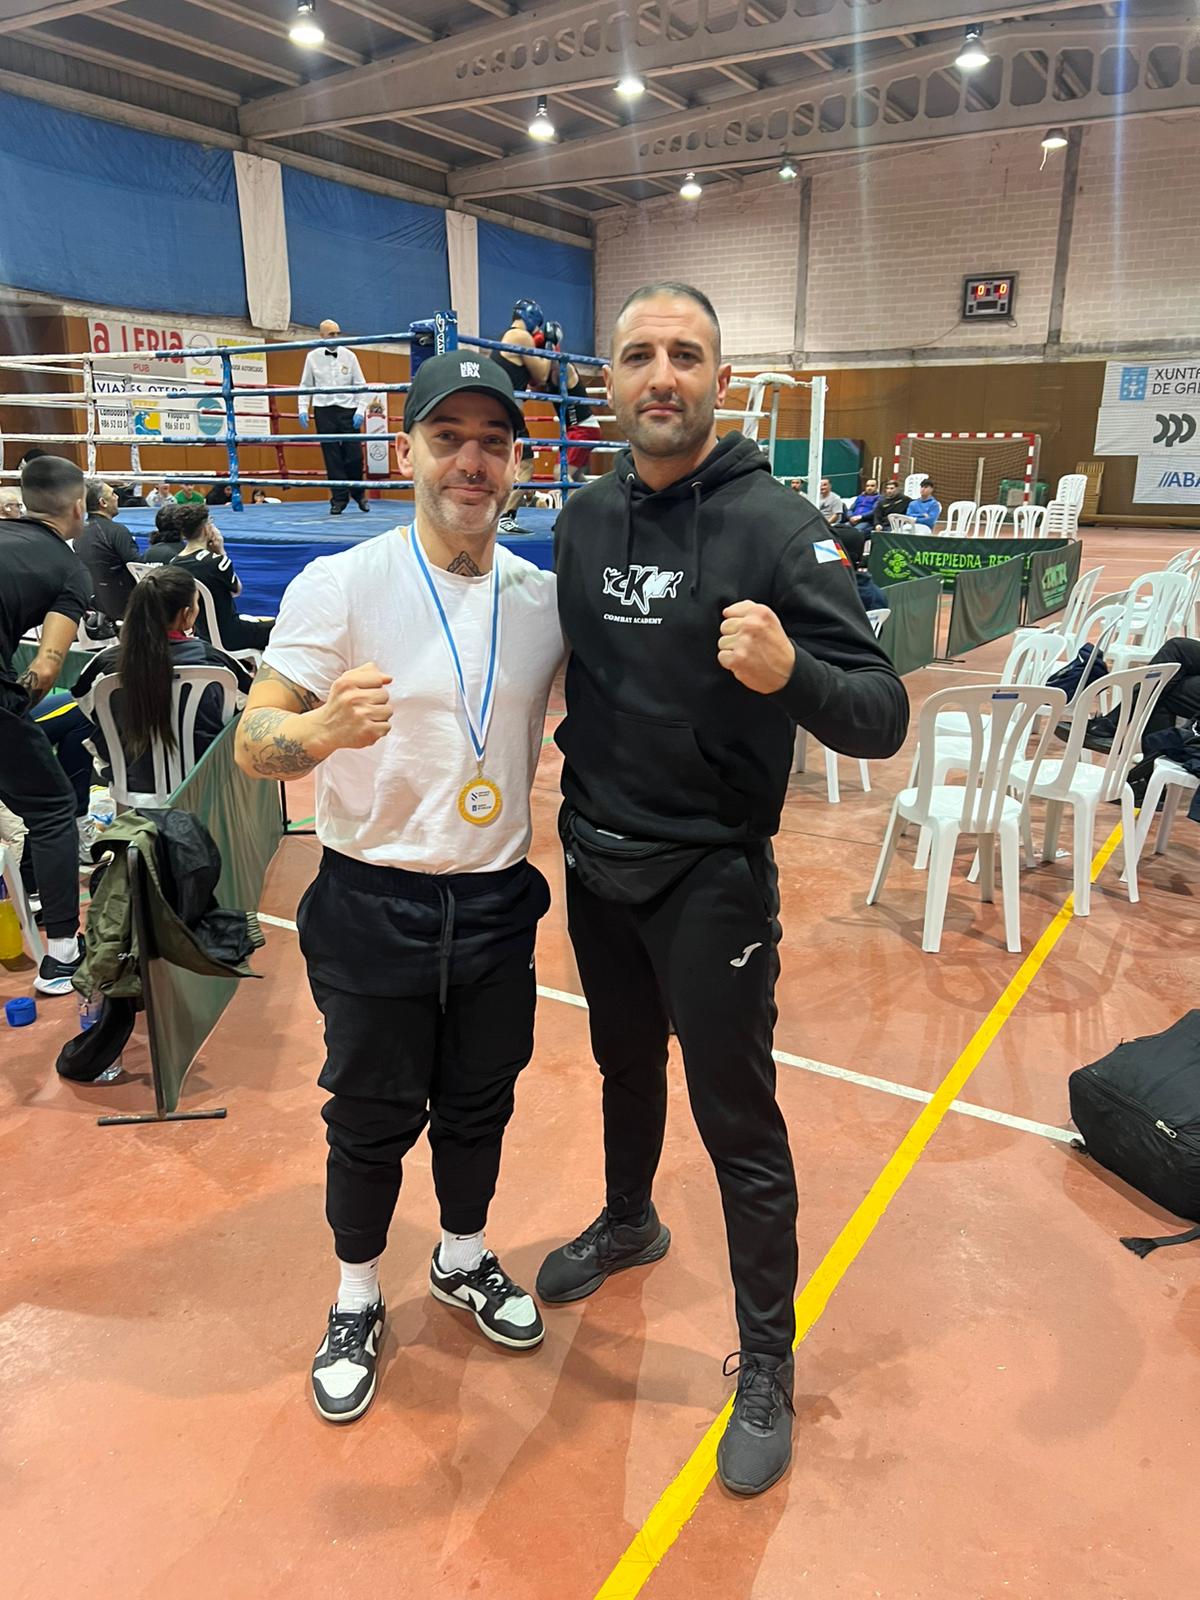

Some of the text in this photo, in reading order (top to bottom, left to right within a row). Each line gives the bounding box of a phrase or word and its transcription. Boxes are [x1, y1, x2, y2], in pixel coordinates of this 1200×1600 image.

[132, 362, 151, 373] PUB
[459, 361, 480, 370] NEW
[460, 369, 481, 379] ERA
[1152, 382, 1172, 395] DE
[914, 551, 983, 569] ARTEPIEDRA
[603, 613, 663, 625] COMBAT ACADEMY
